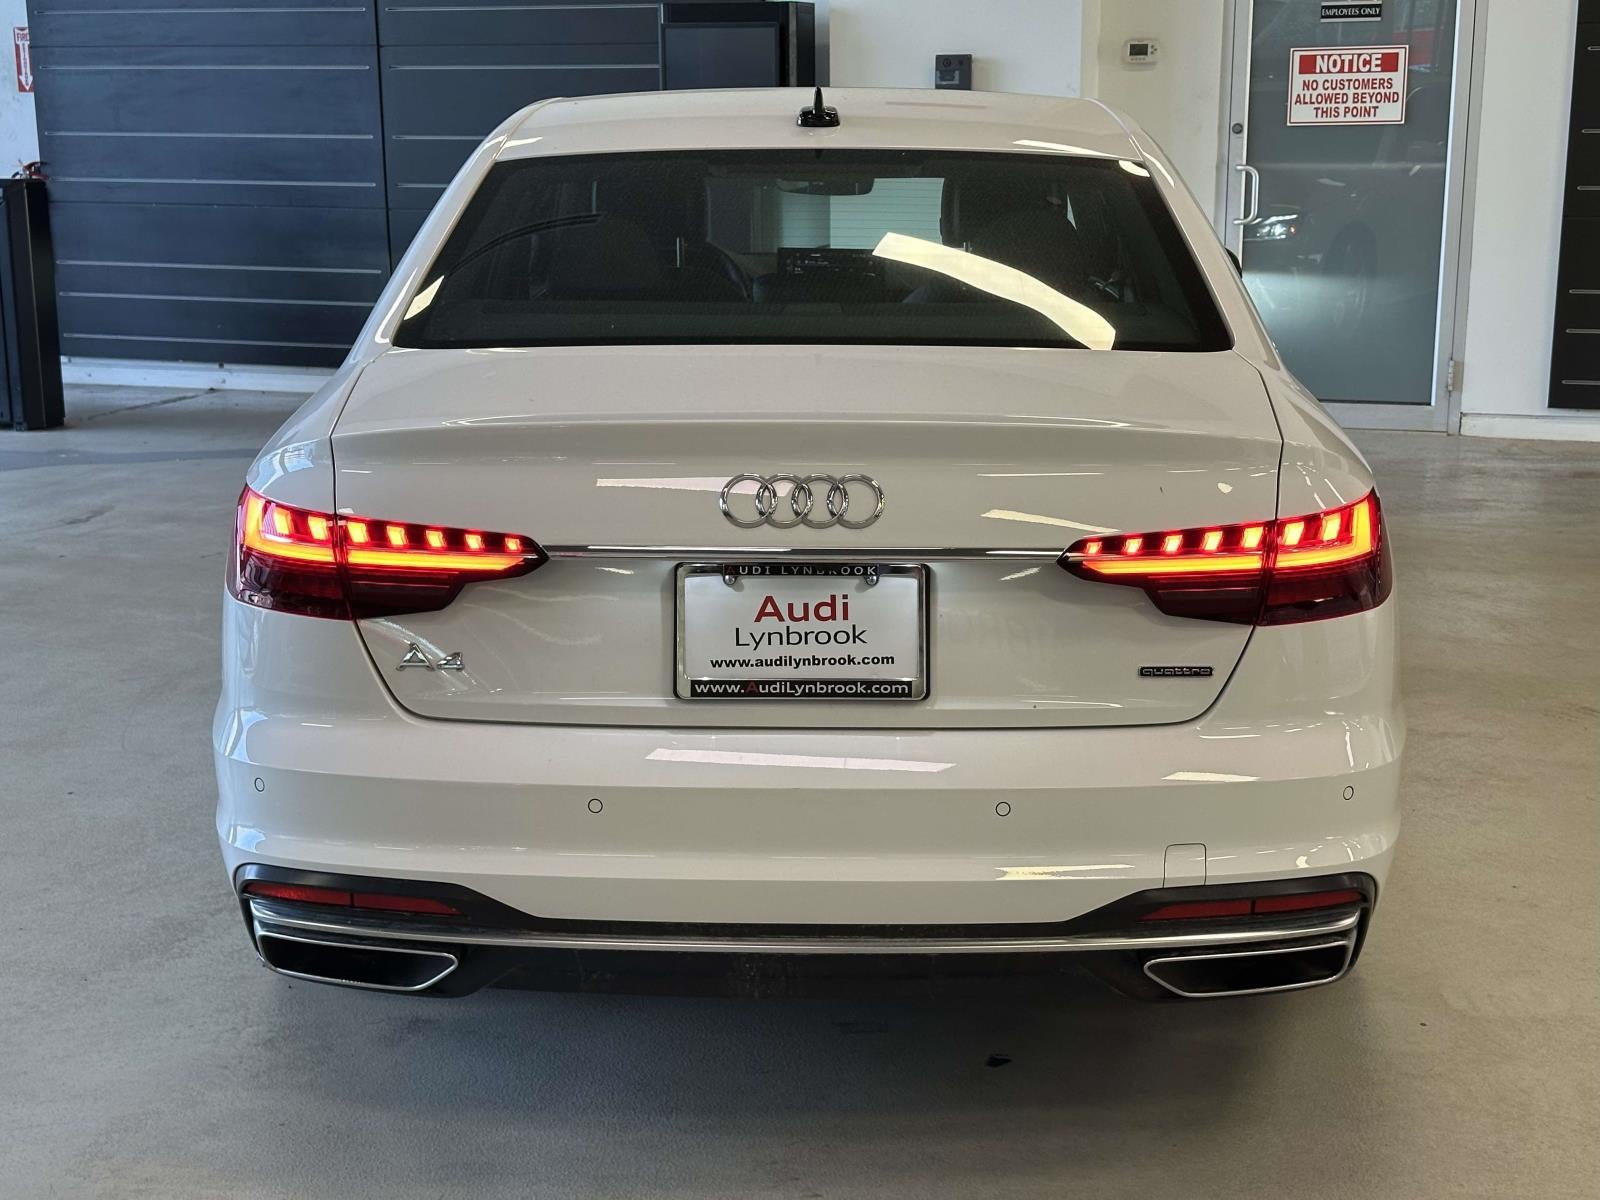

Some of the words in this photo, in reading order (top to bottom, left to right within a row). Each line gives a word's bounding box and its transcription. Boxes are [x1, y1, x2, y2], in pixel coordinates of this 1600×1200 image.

[1321, 8, 1360, 16] EMPLOYEES
[1360, 7, 1381, 15] ONLY
[1315, 53, 1382, 74] NOTICE
[1302, 79, 1319, 91] NO
[1322, 77, 1394, 91] CUSTOMERS
[1294, 92, 1349, 106] ALLOWED
[1352, 91, 1400, 105] BEYOND
[1314, 106, 1341, 119] THIS
[1343, 105, 1380, 118] POINT
[726, 566, 772, 576] AUDI
[753, 594, 850, 623] Audi
[735, 624, 868, 651] Lynbrook
[396, 642, 465, 672] A4
[710, 654, 896, 670] www.audilynbrook.com
[1142, 667, 1211, 677] quattro
[695, 679, 910, 697] www.AudiLynbrook.com
